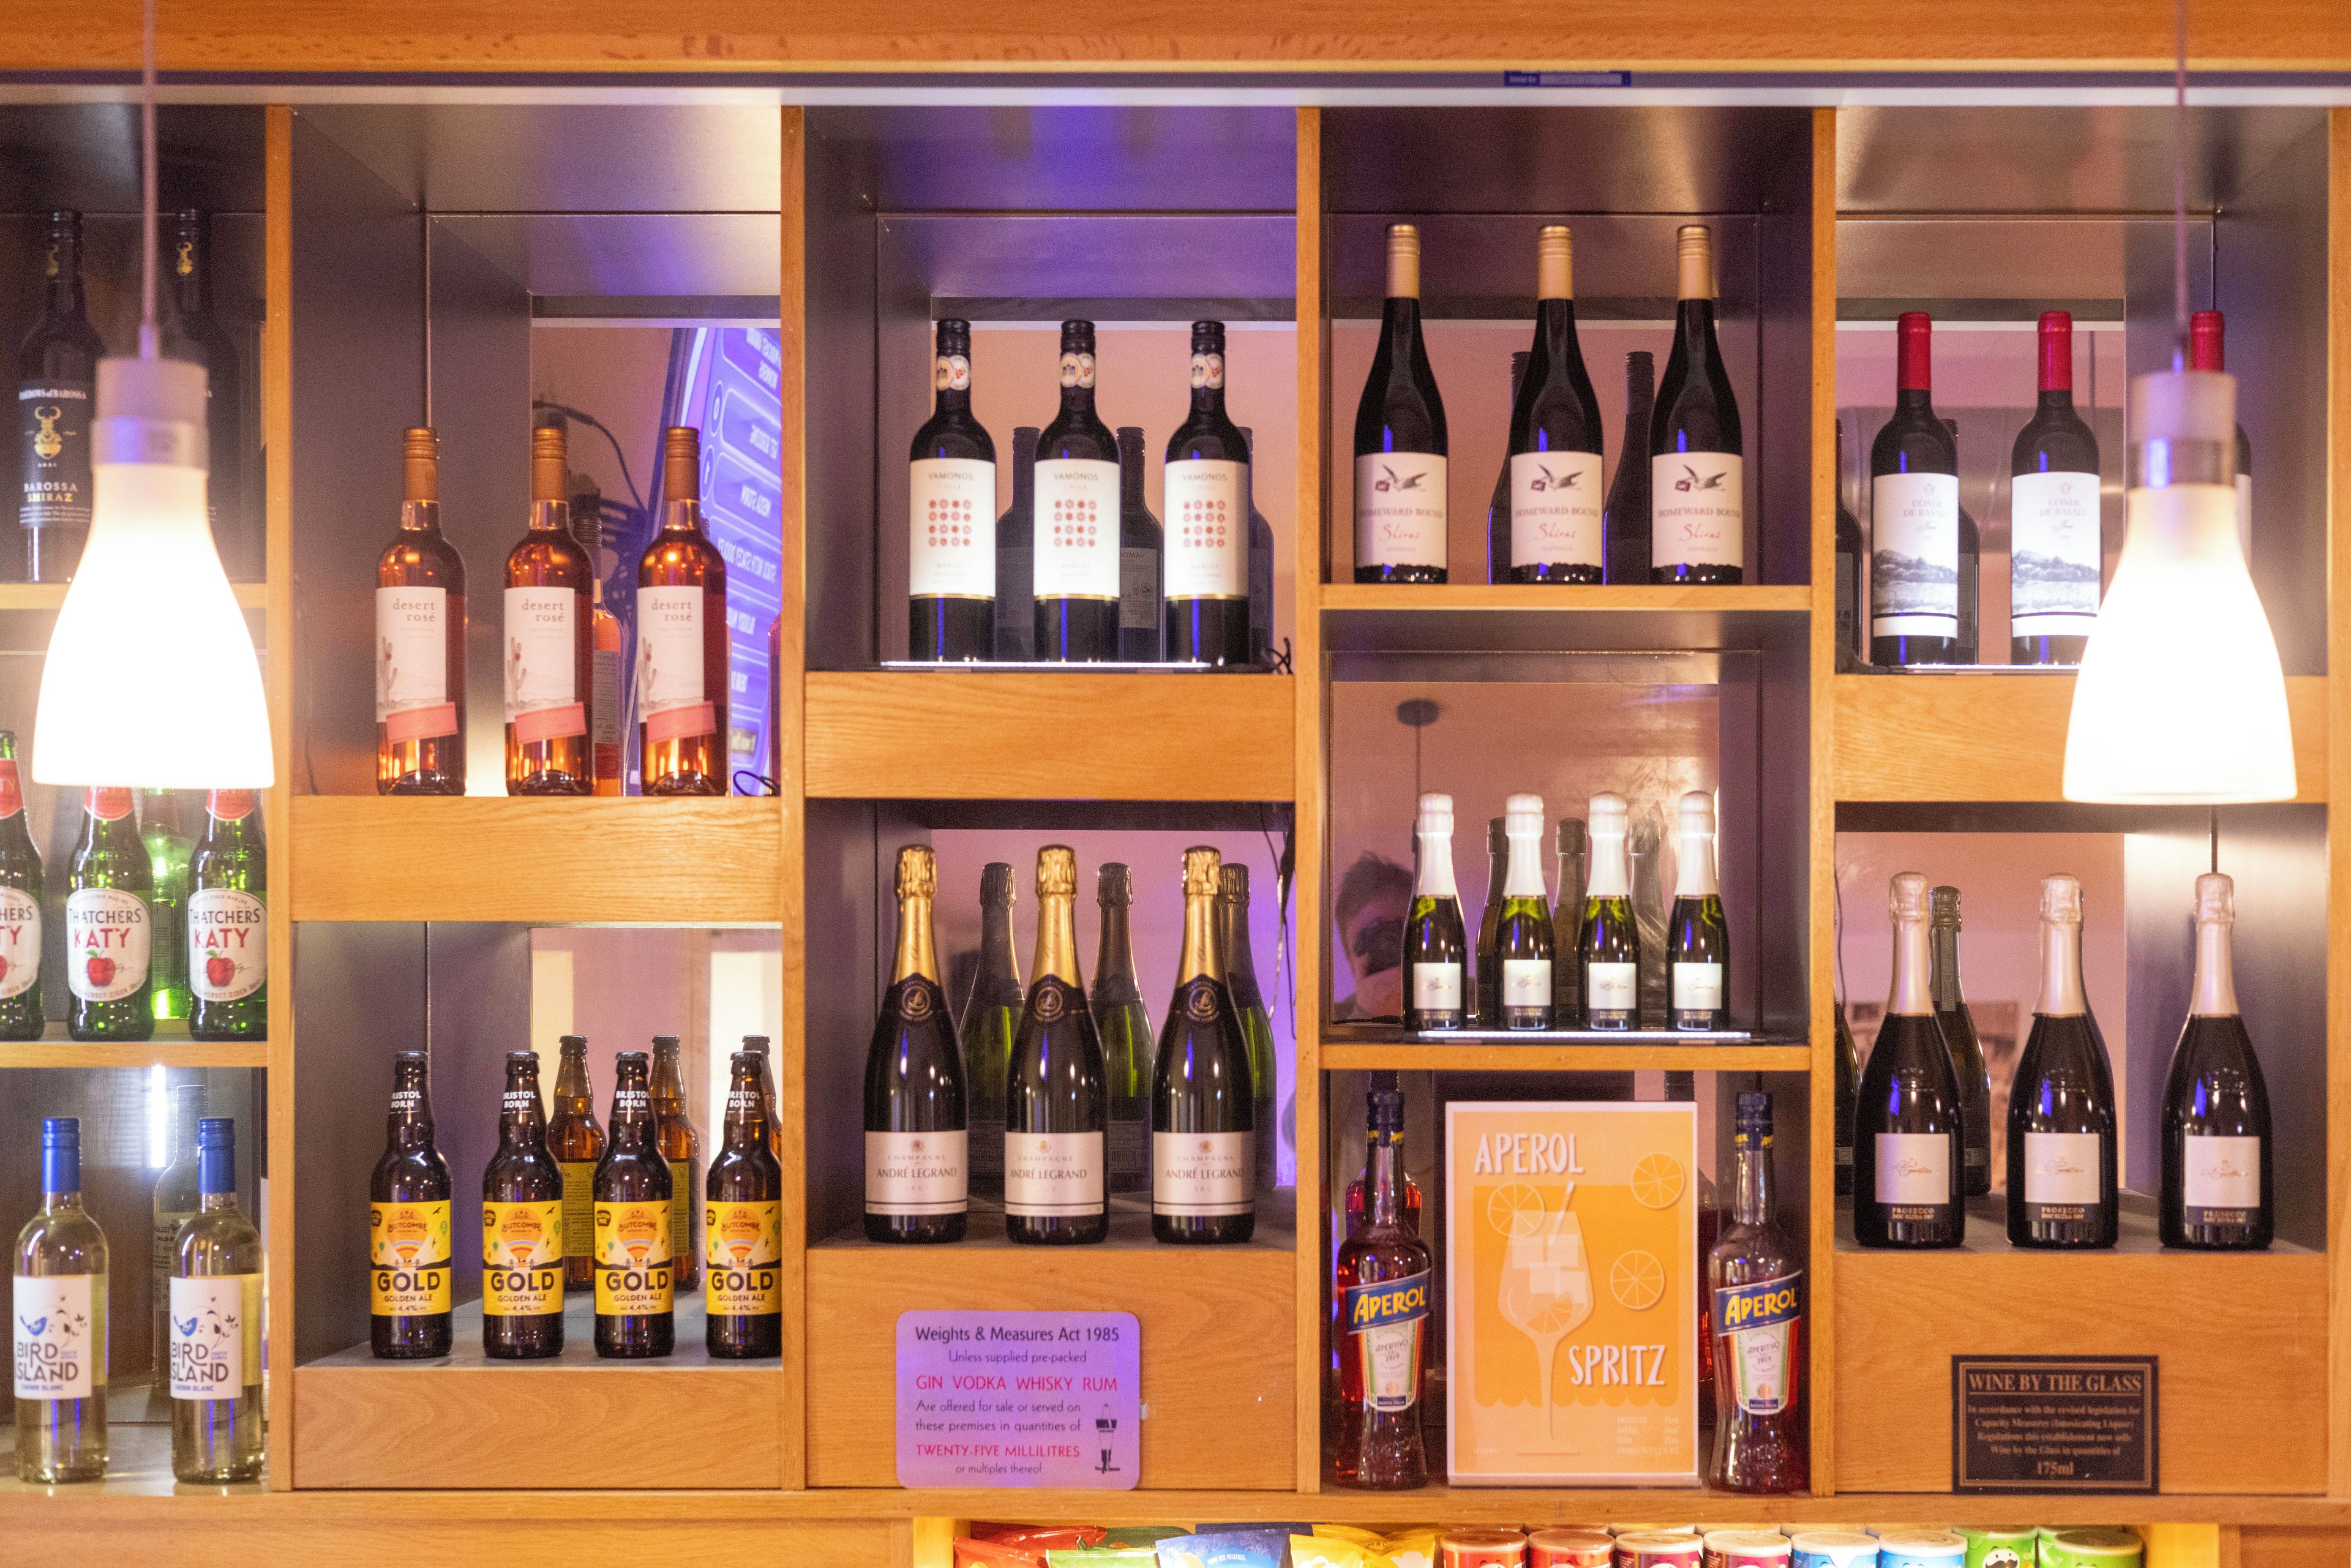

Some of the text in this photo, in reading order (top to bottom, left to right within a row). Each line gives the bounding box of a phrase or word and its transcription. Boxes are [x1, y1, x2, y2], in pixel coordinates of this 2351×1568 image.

[928, 472, 973, 481] VAMONOS
[1053, 472, 1098, 481] VAMONOS
[1182, 473, 1228, 482] VAMONOS
[24, 482, 78, 492] BAROSSA
[28, 493, 73, 503] SHIRAZ
[1359, 508, 1443, 519] HOMEWARD BOUND
[1515, 508, 1599, 518] HOMEWARD BOUND
[1658, 508, 1740, 518] HOMEWARD BOUND
[1379, 523, 1420, 542] Shiraz
[1534, 523, 1576, 541] Shiraz
[1679, 523, 1721, 542] Shiraz
[392, 599, 435, 611] desert
[521, 599, 564, 611] desert
[651, 599, 692, 610] desert
[407, 612, 436, 622] rosé
[535, 612, 564, 622] rosé
[664, 612, 692, 622] rosé
[69, 908, 142, 924] THATCHERS
[189, 908, 261, 924] THATCHERS
[74, 928, 131, 948] KATY
[195, 928, 250, 948] KATY
[391, 1090, 422, 1100] RISTOL
[615, 1090, 651, 1099] BRISTOL
[729, 1100, 755, 1108] BORN
[1474, 1133, 1584, 1174] APEROL
[876, 1166, 957, 1179] ANDRÉ LEGRAND
[1010, 1166, 1087, 1179] ANDRÉ LEGRAND
[1165, 1166, 1245, 1179] ANDRÉ LEGRAND
[388, 1221, 427, 1232] BUTCOMBE
[503, 1221, 542, 1232] BUTCOMBE
[618, 1221, 658, 1232] BUTCOMBE
[722, 1221, 760, 1232] BUTCOMBE
[378, 1272, 441, 1292] GOLD
[491, 1272, 555, 1292] GOLD
[606, 1270, 668, 1291] GOLD
[711, 1271, 774, 1291] GOLD
[1353, 1286, 1426, 1324] APEROL
[1725, 1288, 1798, 1326] APEROL
[915, 1326, 1120, 1344] Weights & Measures Act 1985
[17, 1342, 58, 1368] BIRD
[171, 1341, 209, 1368] BIRD
[948, 1350, 1087, 1364] Unless supplied pre-packed
[17, 1362, 78, 1382] SLAND
[171, 1362, 229, 1382] SLAND
[1569, 1345, 1667, 1387] SPRITZ
[916, 1375, 1117, 1392] GIN VODKA WHISKY RUM
[1969, 1374, 2142, 1392] WINE BY THE GLASS
[916, 1400, 1081, 1412] Are offered for sale or served on
[1968, 1405, 1977, 1414] In
[2025, 1405, 2042, 1414] with
[2044, 1405, 2056, 1414] the
[2058, 1406, 2085, 1414] revised
[2129, 1406, 2141, 1415] for
[916, 1419, 1082, 1433] these premises in quantities of
[1974, 1418, 2009, 1428] Capacity
[2012, 1418, 2049, 1427] Measures
[2025, 1432, 2040, 1441] this
[2042, 1433, 2094, 1442] establishment
[1005, 1445, 1080, 1458] MILLILITRES
[1990, 1446, 2011, 1455] Wine
[2014, 1446, 2022, 1457] by
[2025, 1446, 2037, 1455] the
[2072, 1447, 2111, 1457] quantities
[2113, 1446, 2121, 1455] of
[956, 1464, 1042, 1476] or multiples thereof
[2037, 1461, 2074, 1476] 175ml
